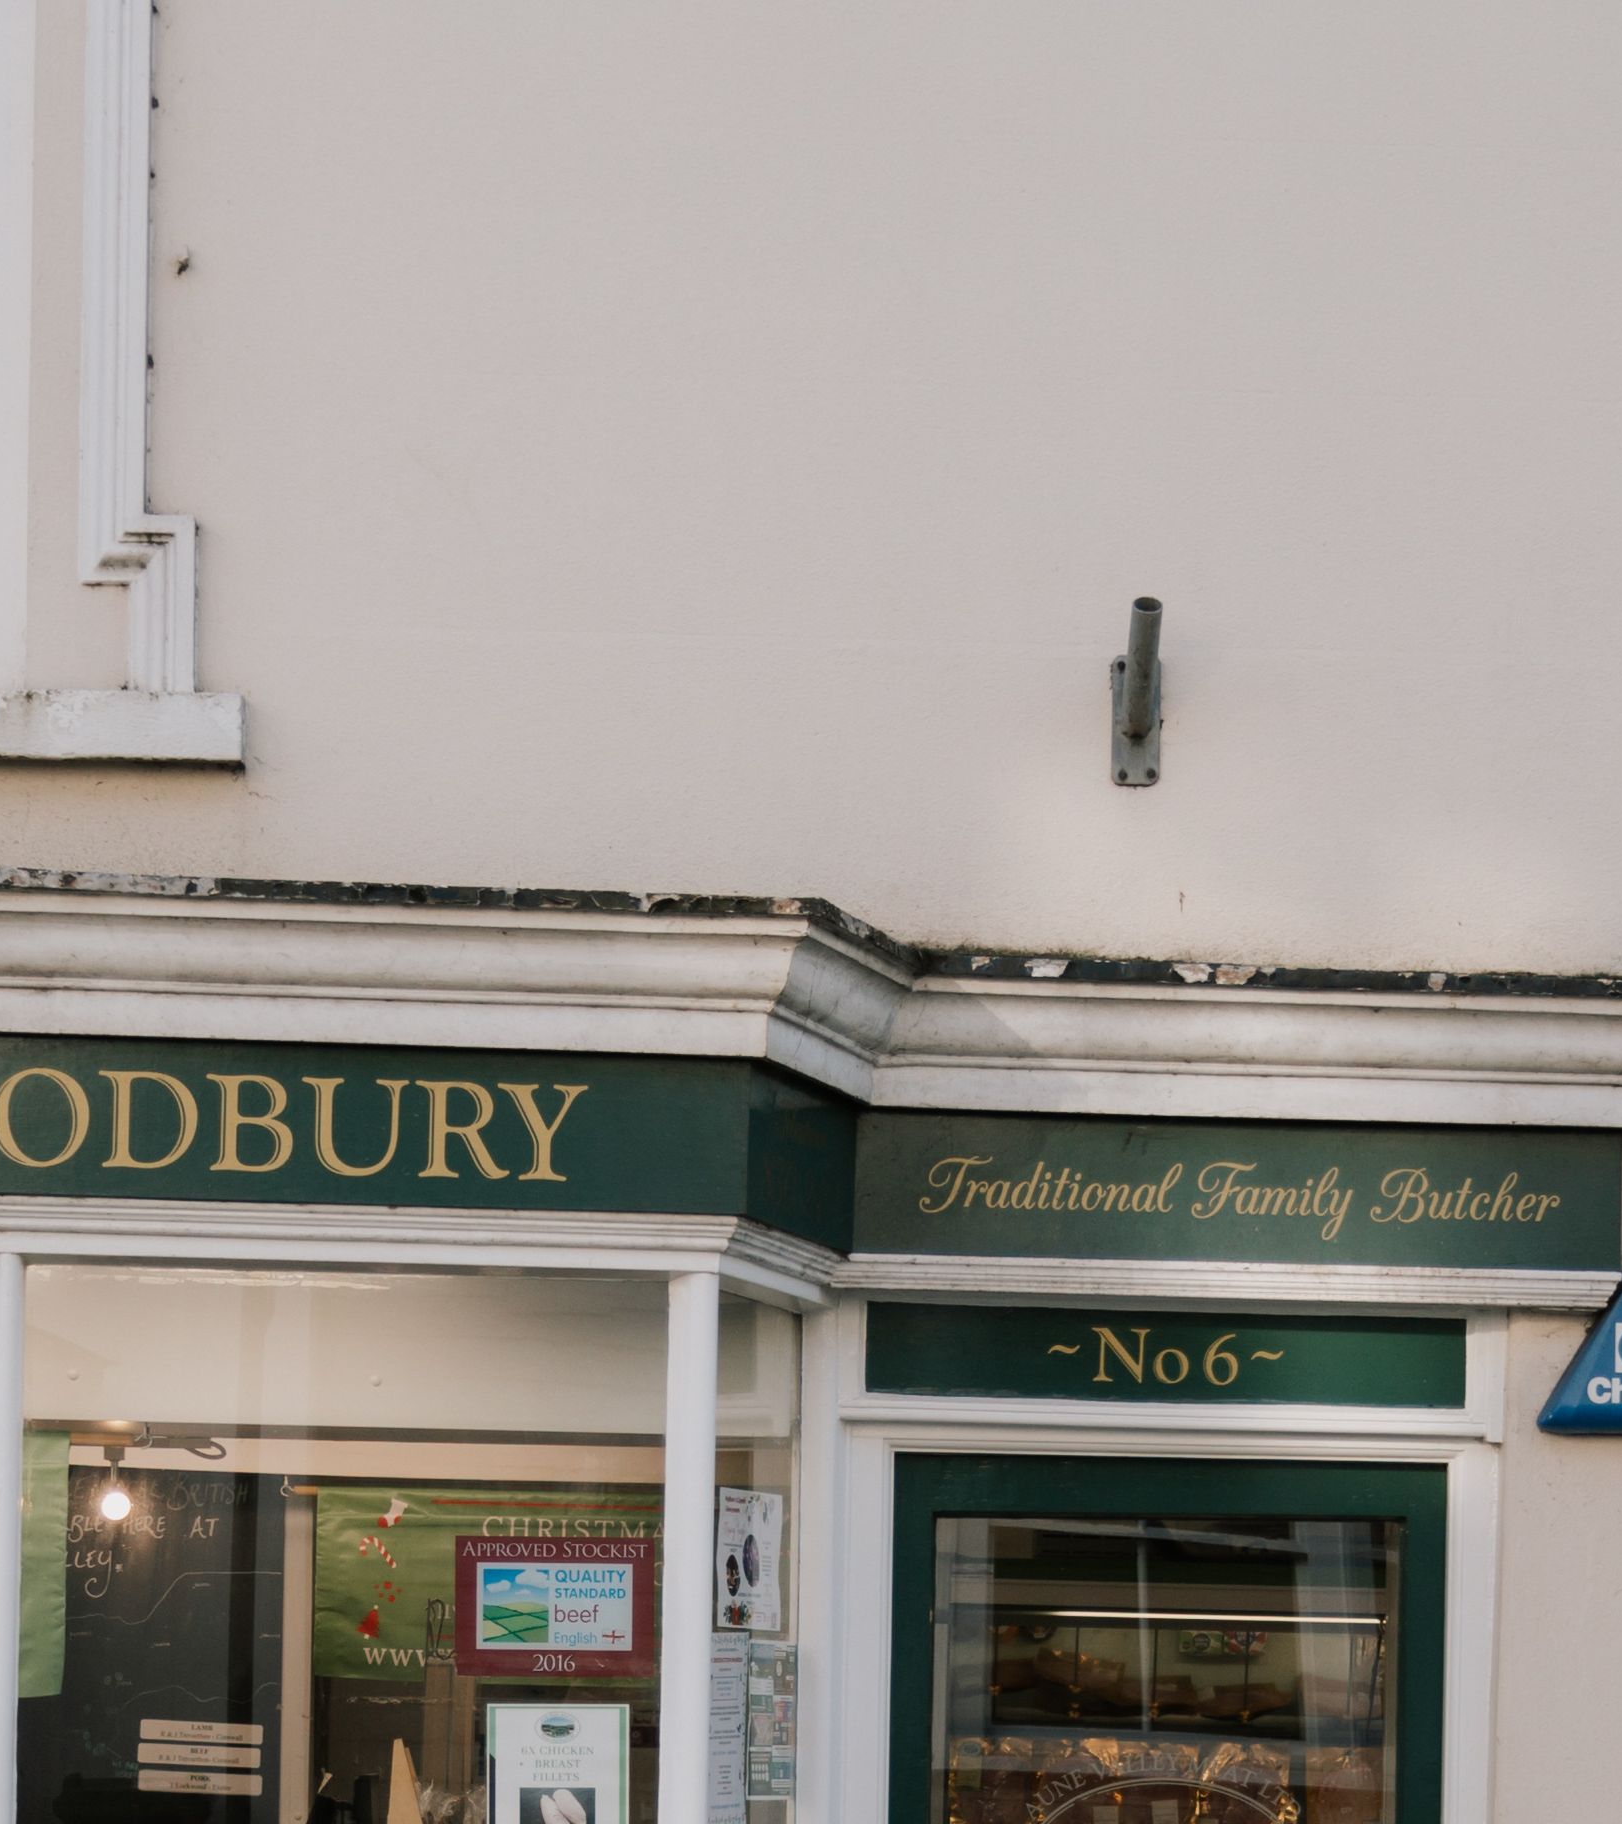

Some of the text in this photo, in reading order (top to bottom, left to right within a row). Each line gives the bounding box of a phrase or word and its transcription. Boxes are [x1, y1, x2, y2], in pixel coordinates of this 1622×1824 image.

[919, 1155, 1561, 1241] Traditional Family Butcher
[190, 1517, 220, 1539] AT
[462, 1540, 649, 1559] APPROVED STOCKIST
[554, 1569, 626, 1584] QUALITY
[554, 1586, 627, 1599] STANDARD
[553, 1604, 600, 1624] beef
[553, 1631, 598, 1647] English
[532, 1653, 576, 1673] 2016
[539, 1746, 595, 1756] CHICKEN
[534, 1759, 582, 1769] BREAST
[532, 1772, 580, 1782] FILLETS
